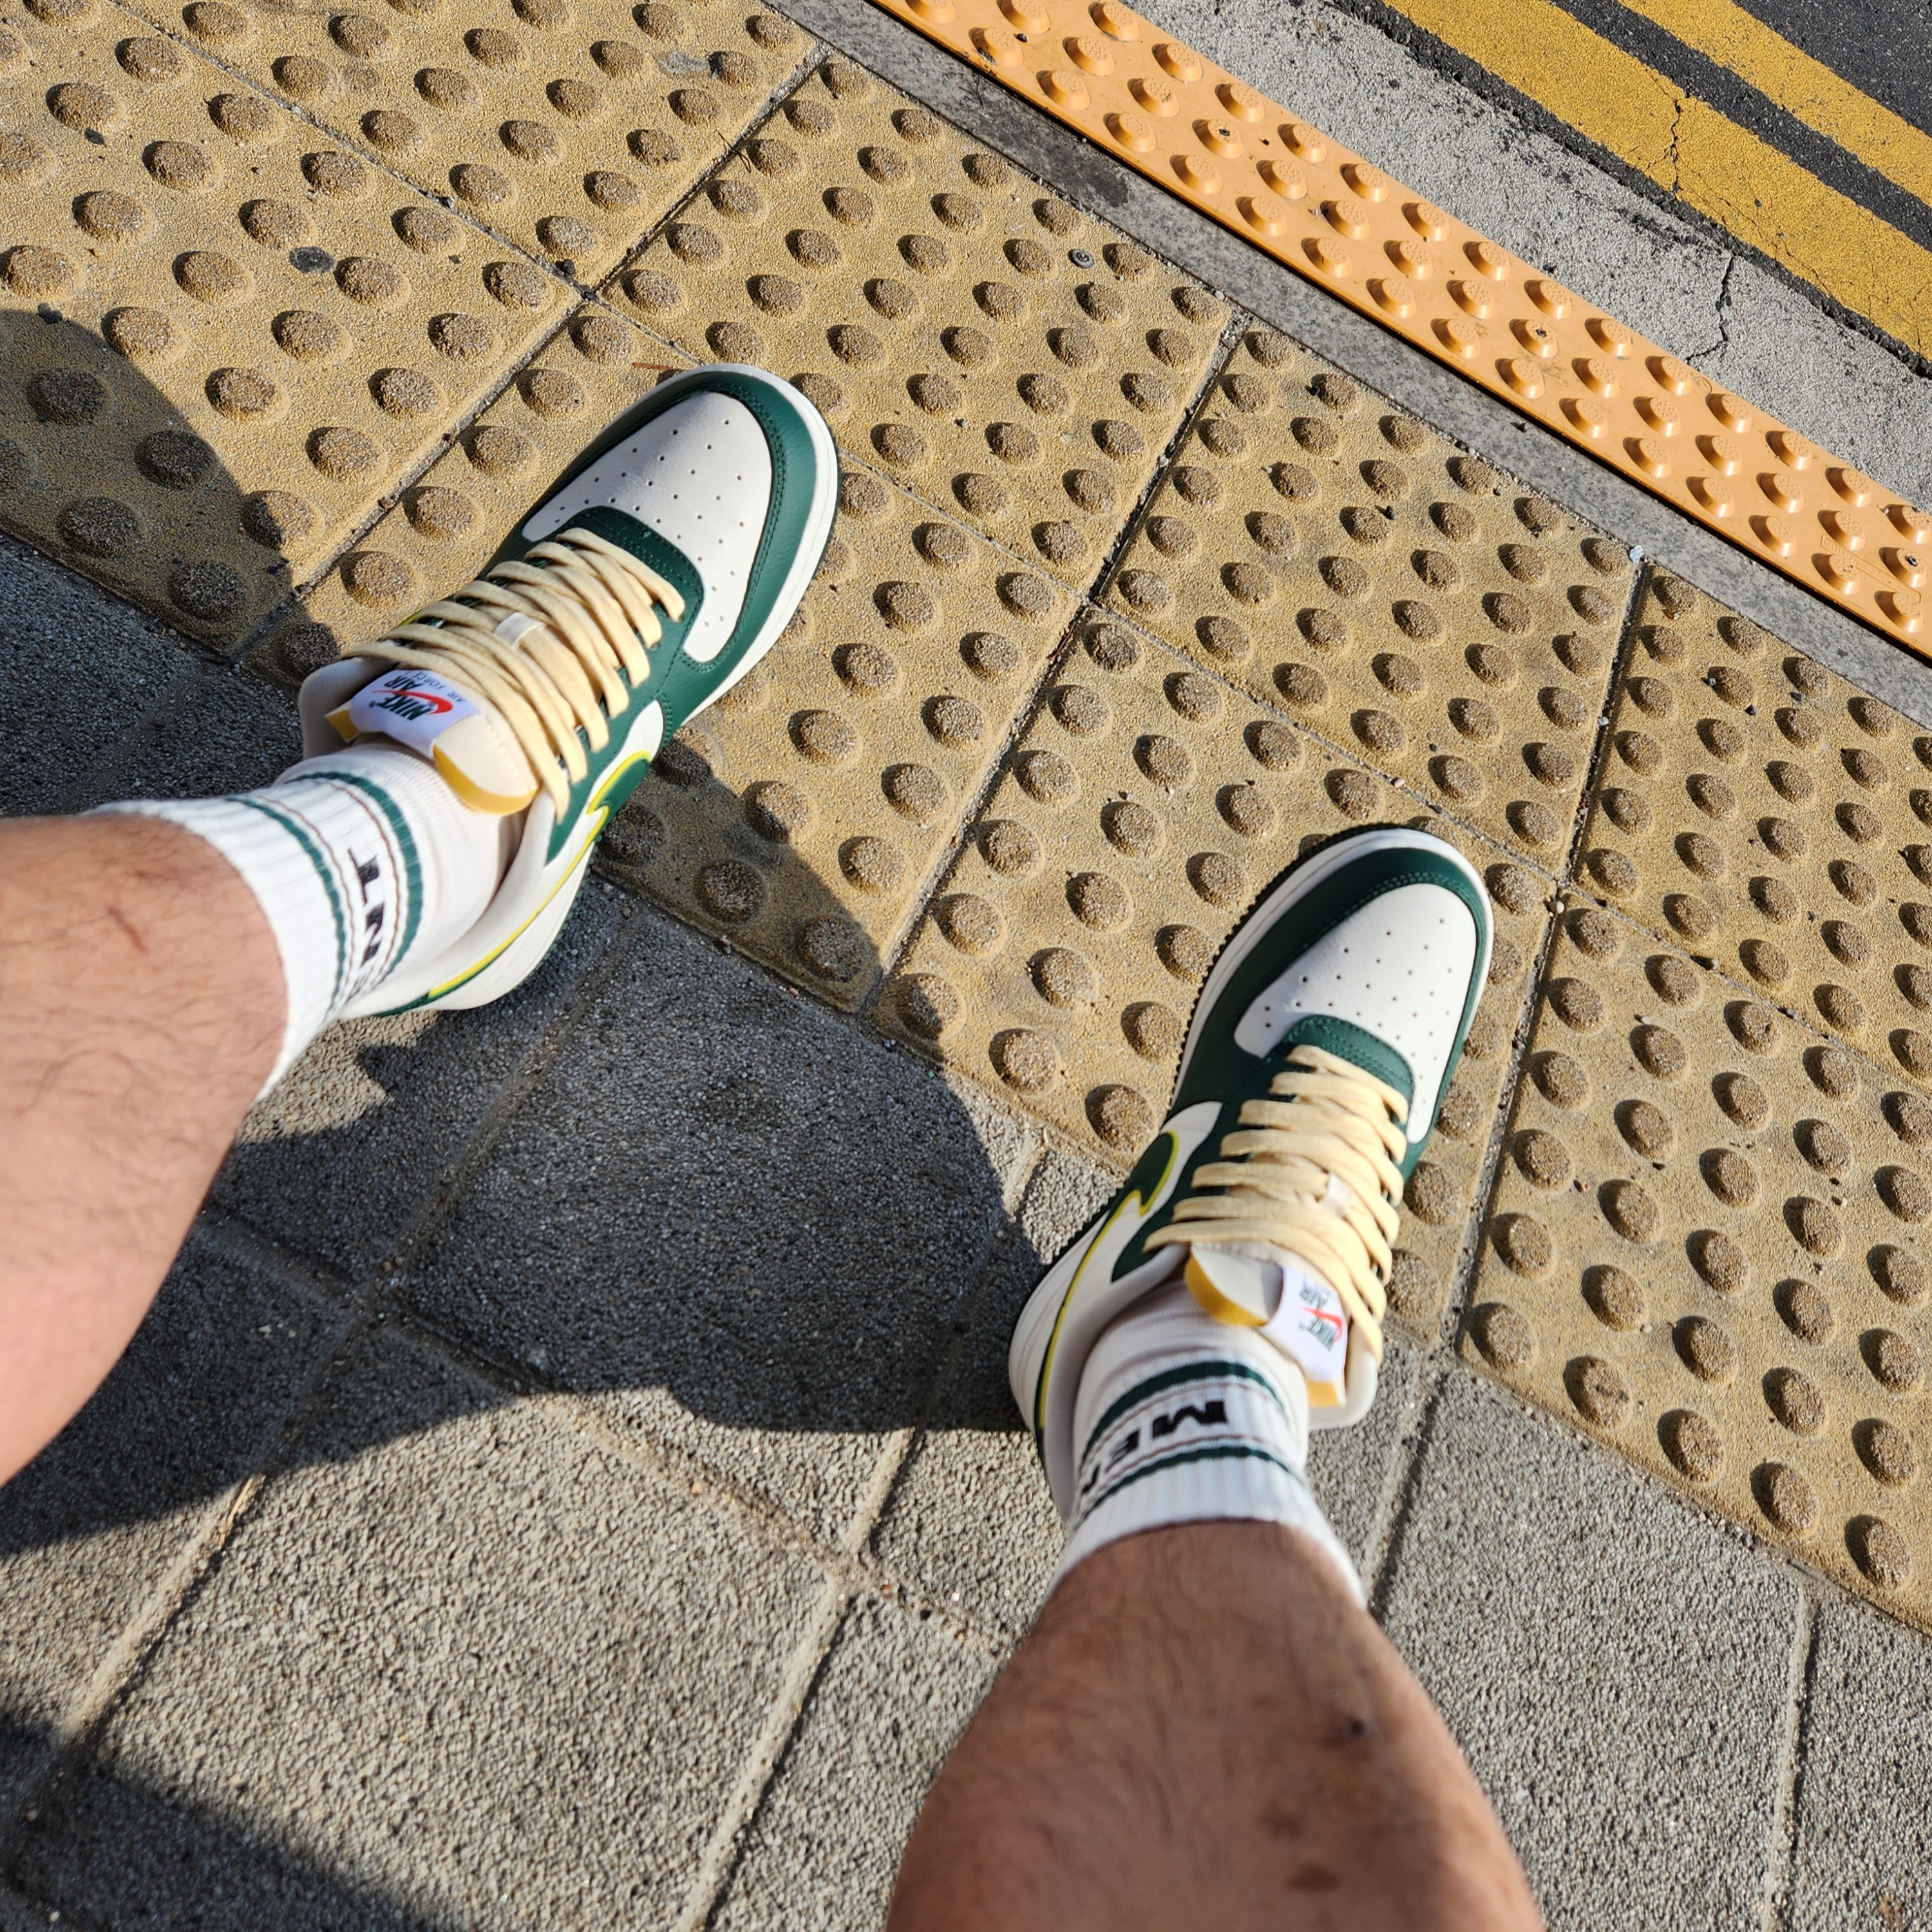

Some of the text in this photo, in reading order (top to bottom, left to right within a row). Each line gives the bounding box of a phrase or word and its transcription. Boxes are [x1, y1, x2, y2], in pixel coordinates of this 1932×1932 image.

[384, 674, 423, 692] AIR
[447, 690, 467, 703] AIR
[376, 696, 434, 721] NIKE
[1300, 1287, 1327, 1310] AIR
